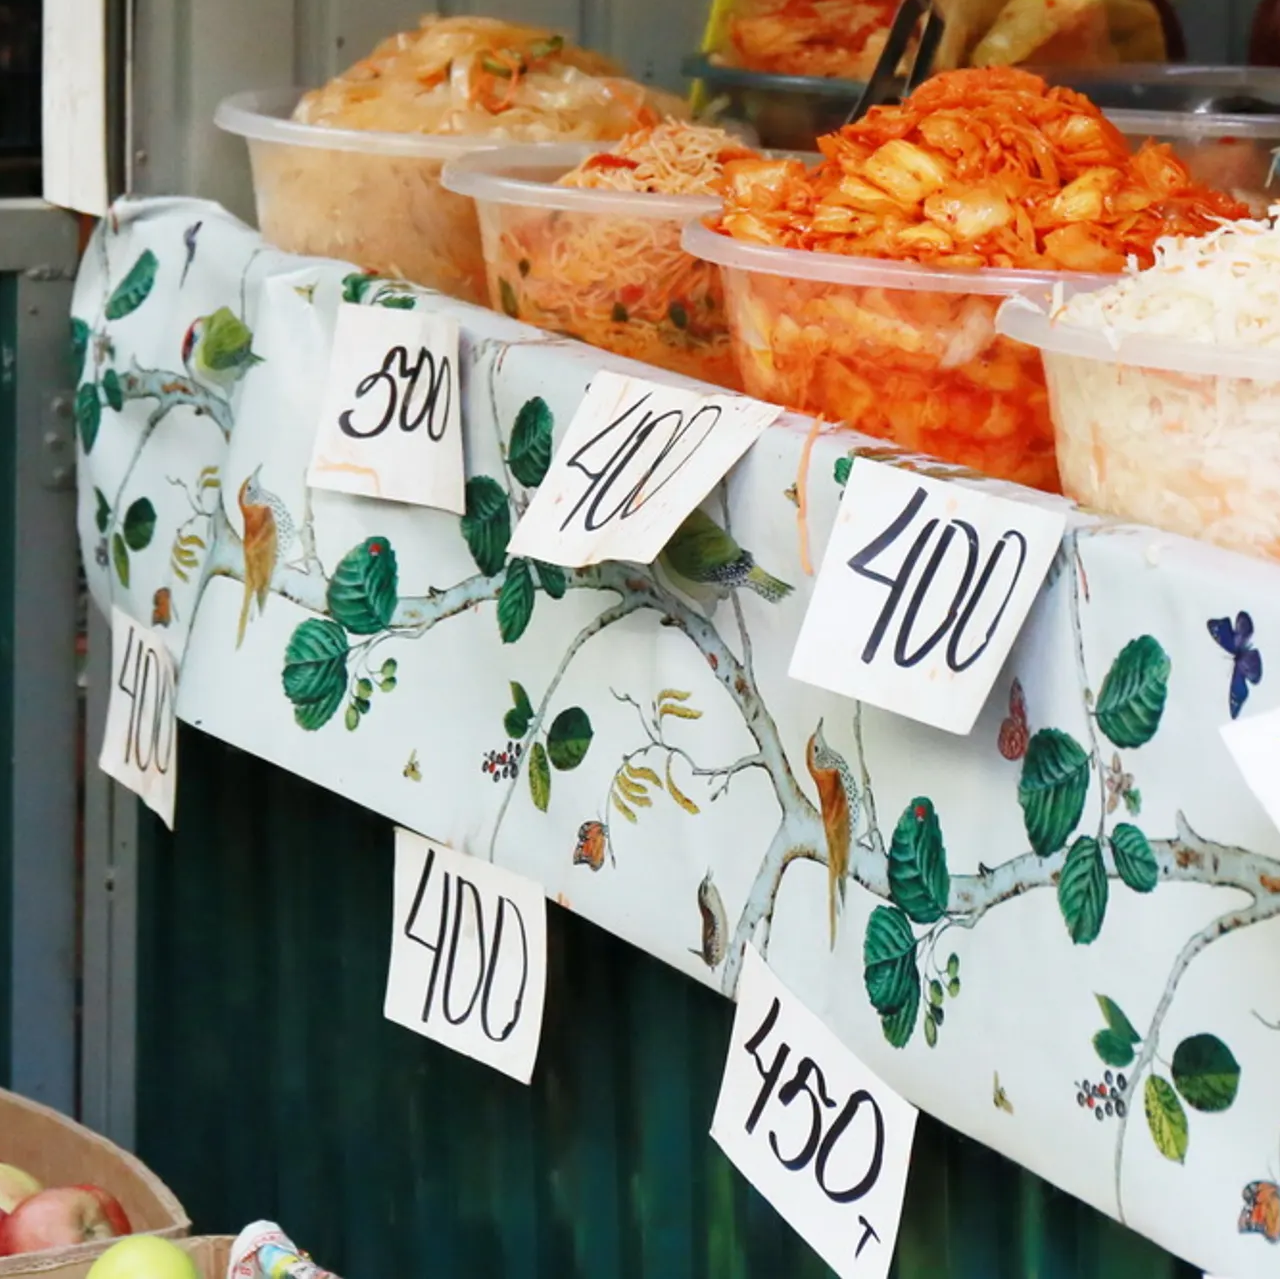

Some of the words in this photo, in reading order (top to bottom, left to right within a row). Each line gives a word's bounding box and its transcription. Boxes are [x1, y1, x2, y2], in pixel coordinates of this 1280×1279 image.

[338, 345, 452, 443] 500
[559, 391, 722, 532] 400
[848, 487, 1028, 673] 400
[118, 625, 174, 774] 400
[404, 847, 529, 1042] 400
[744, 996, 885, 1204] 450
